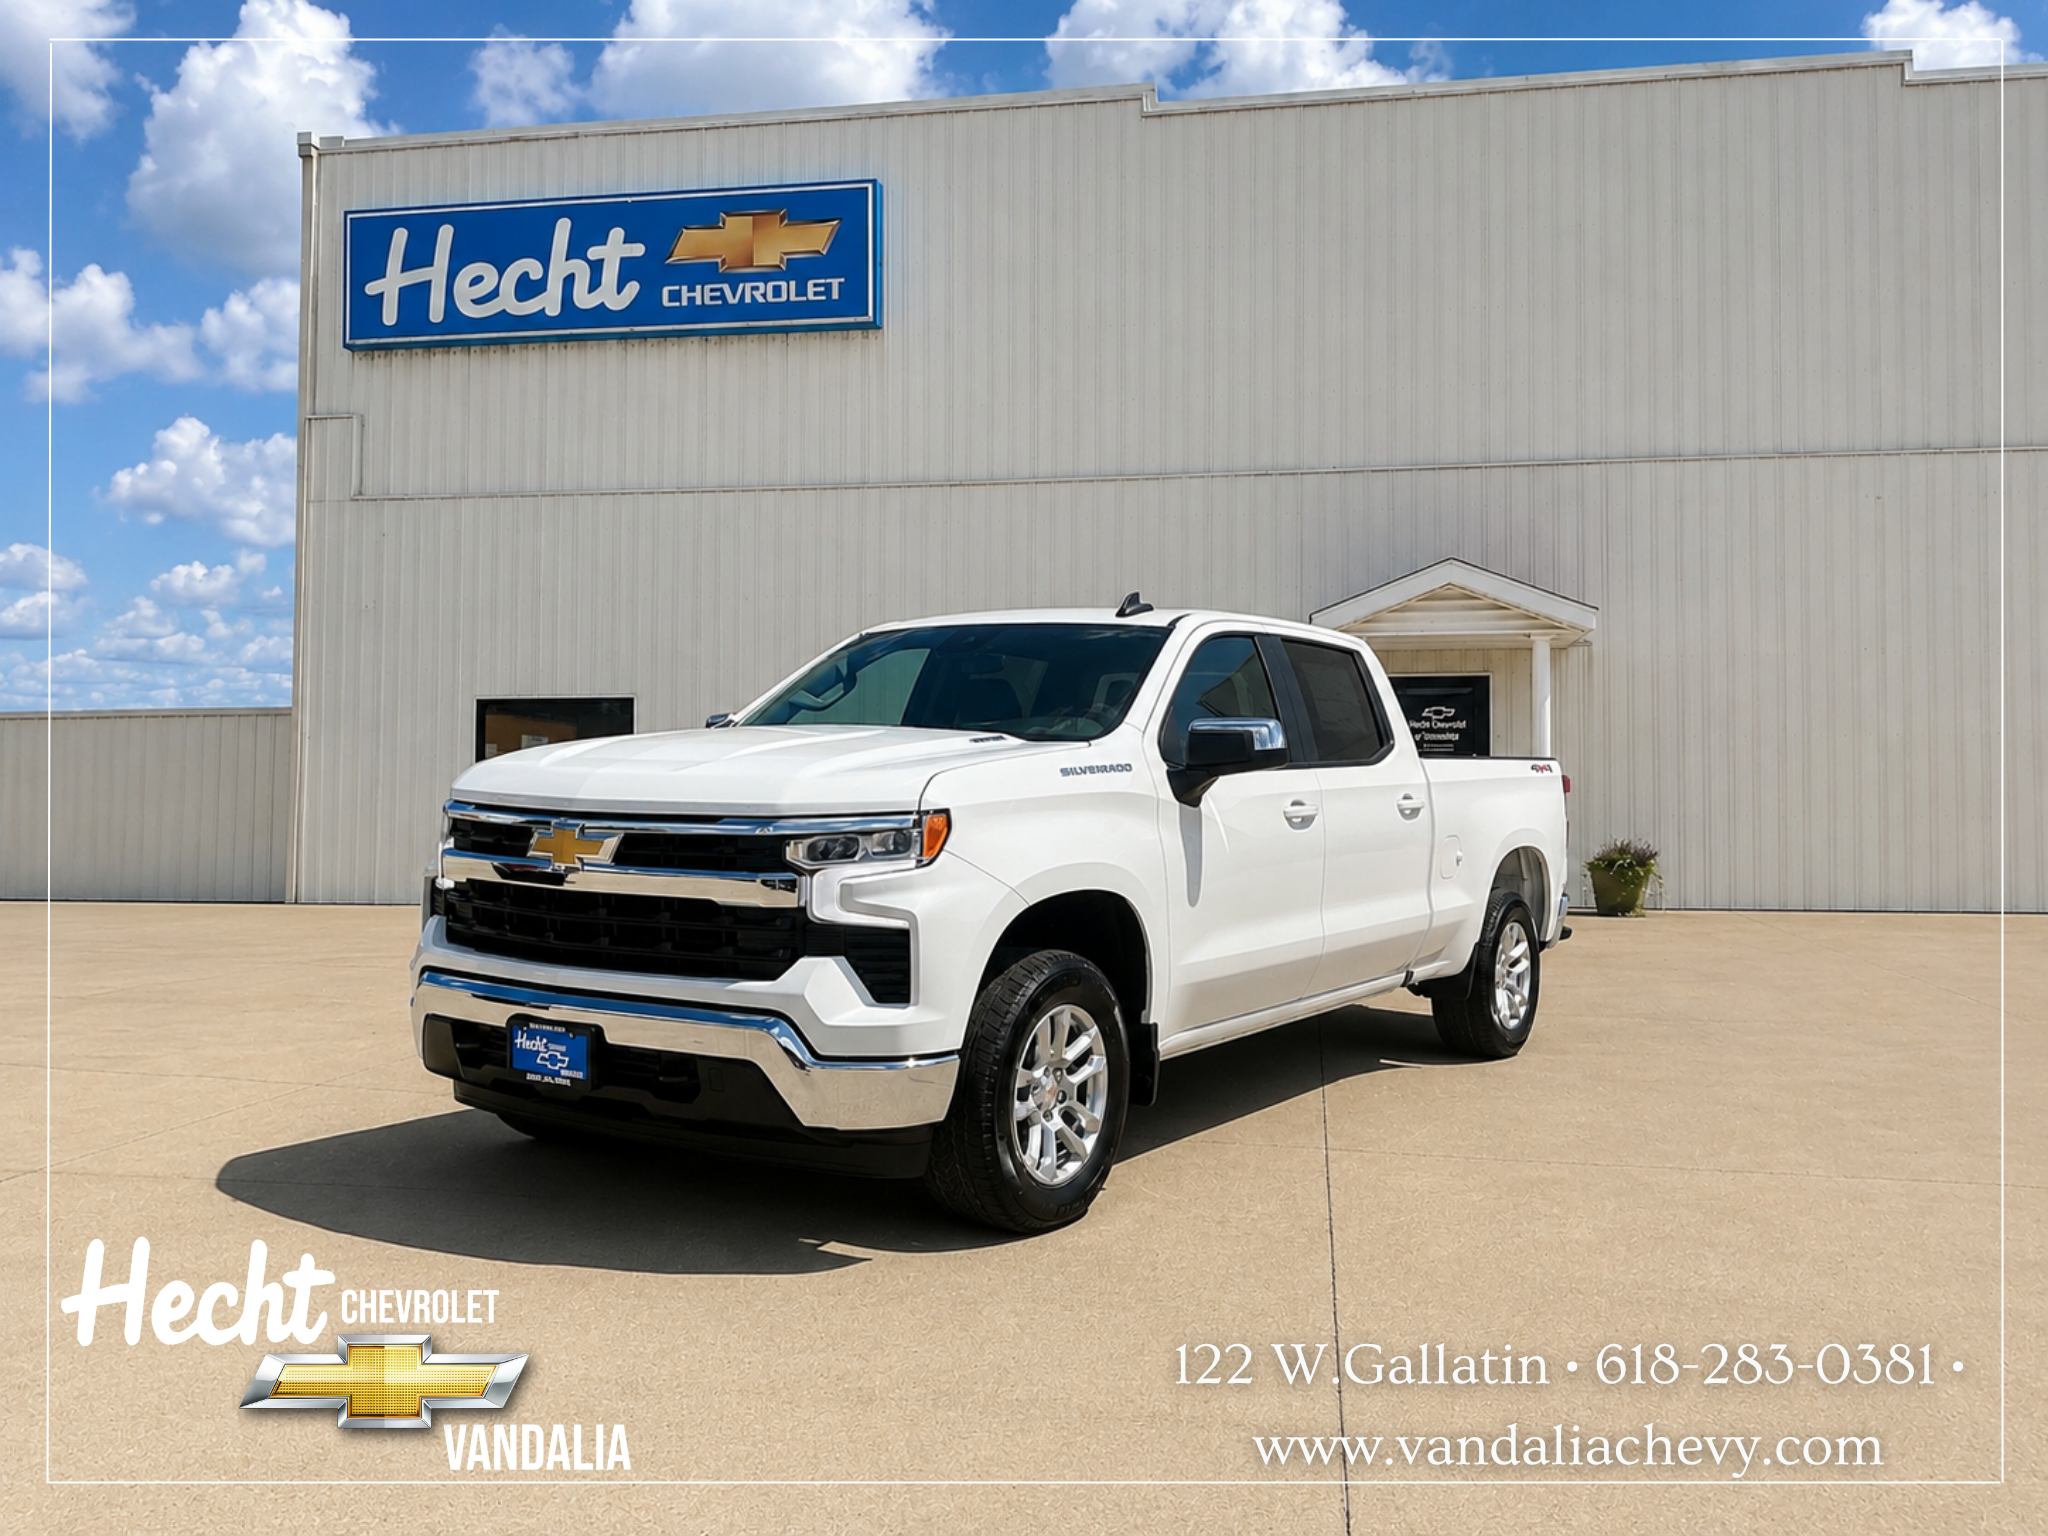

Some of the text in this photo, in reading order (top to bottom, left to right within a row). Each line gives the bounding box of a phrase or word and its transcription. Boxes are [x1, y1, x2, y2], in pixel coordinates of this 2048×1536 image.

[364, 217, 646, 326] Hecht
[661, 277, 845, 307] CHEVROLET
[1060, 763, 1133, 777] SILVERADO
